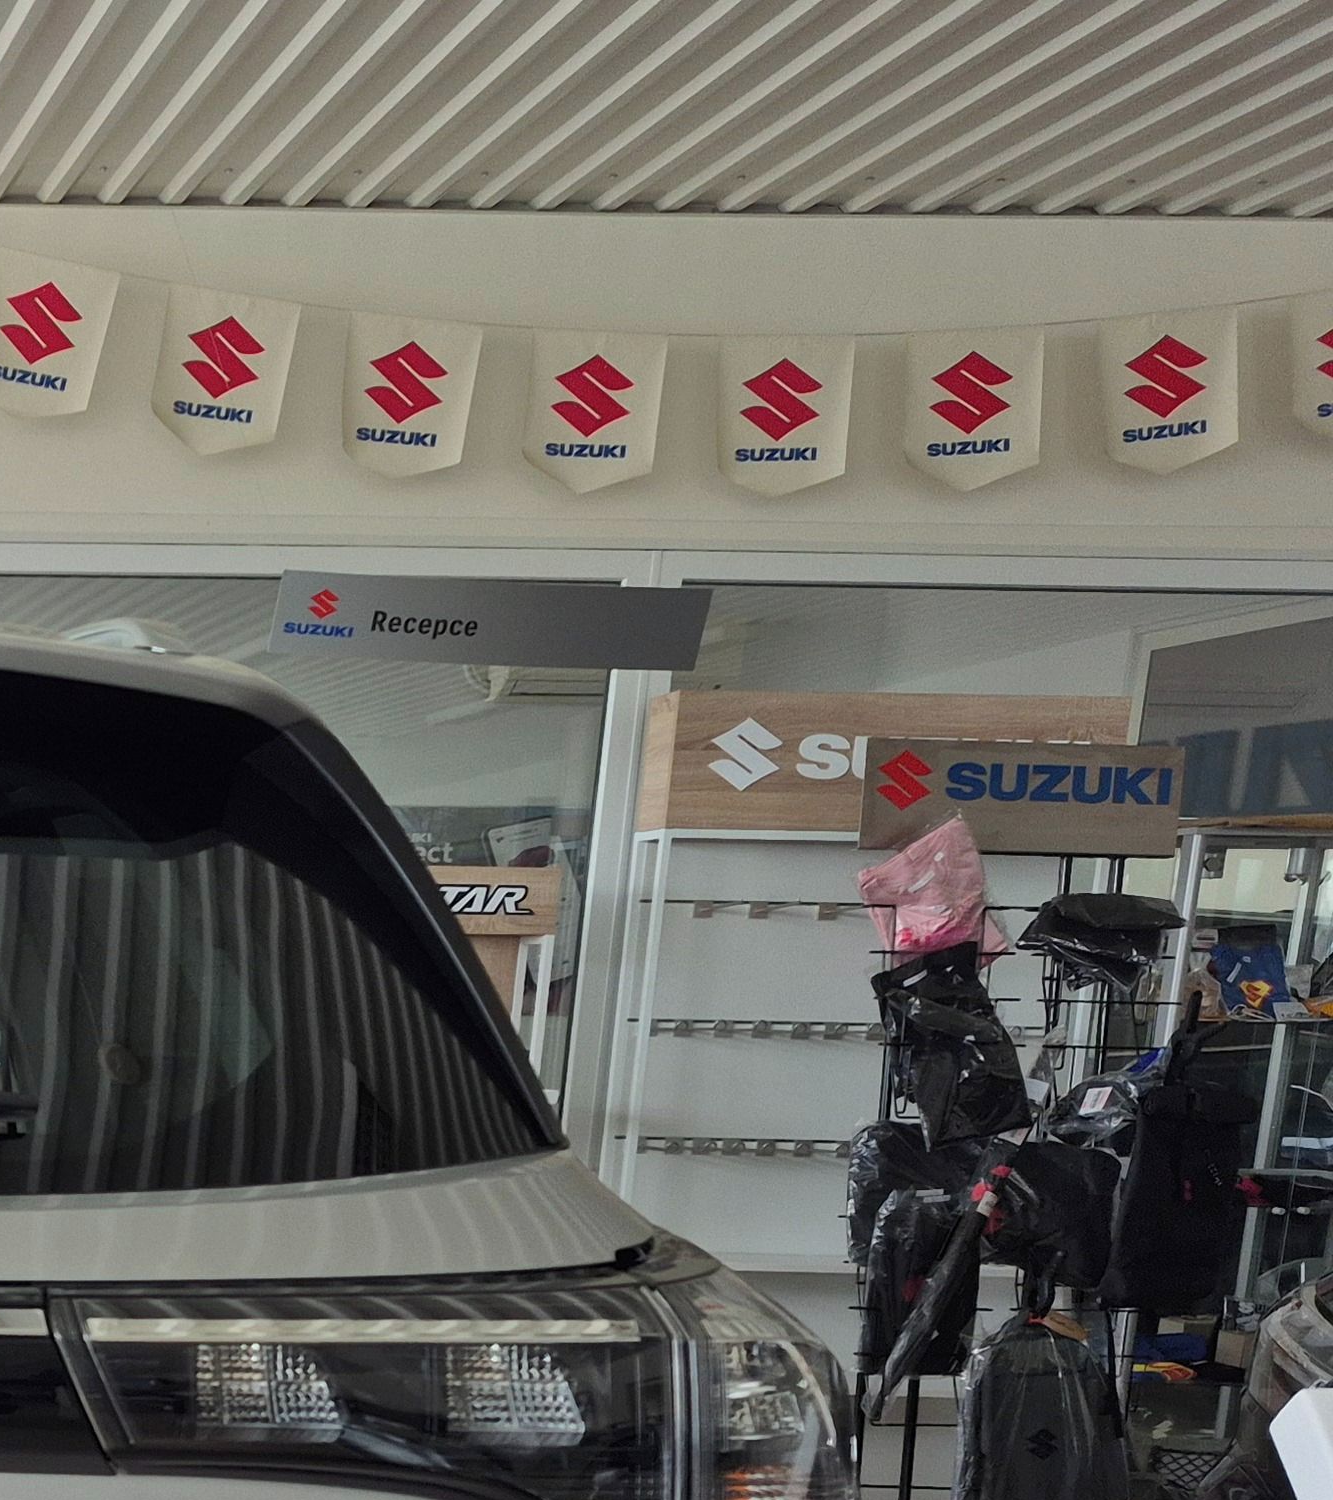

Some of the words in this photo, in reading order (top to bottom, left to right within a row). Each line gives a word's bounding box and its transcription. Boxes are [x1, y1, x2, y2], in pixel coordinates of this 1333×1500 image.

[172, 400, 253, 425] SUZUKI
[355, 426, 438, 448] SUZUKI
[1122, 418, 1208, 444] SUZUKI
[544, 442, 627, 459] SUZUKI
[734, 446, 818, 463] SUZUKI
[926, 437, 1010, 458] SUZUKI
[282, 621, 355, 639] SUZUKI
[370, 610, 479, 640] Recepce
[945, 761, 1174, 806] SUZUKI
[439, 885, 534, 915] TAR
